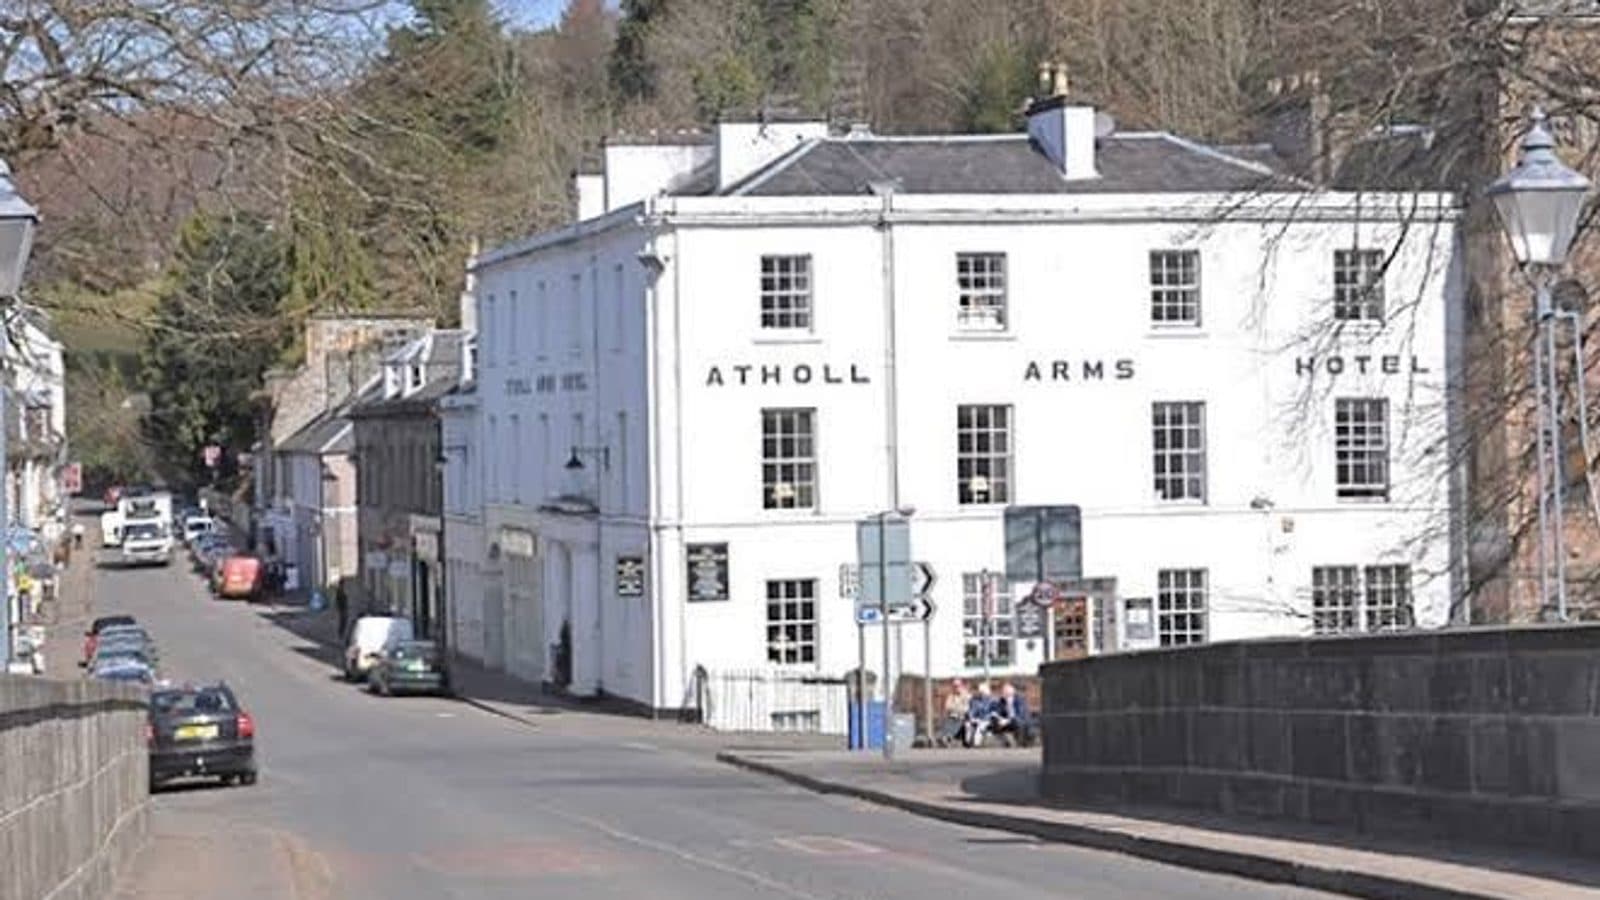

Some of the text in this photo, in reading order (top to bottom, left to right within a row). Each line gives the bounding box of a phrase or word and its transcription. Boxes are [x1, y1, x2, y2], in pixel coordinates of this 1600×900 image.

[706, 354, 1430, 386] ATHOLL ARMS HOTEL
